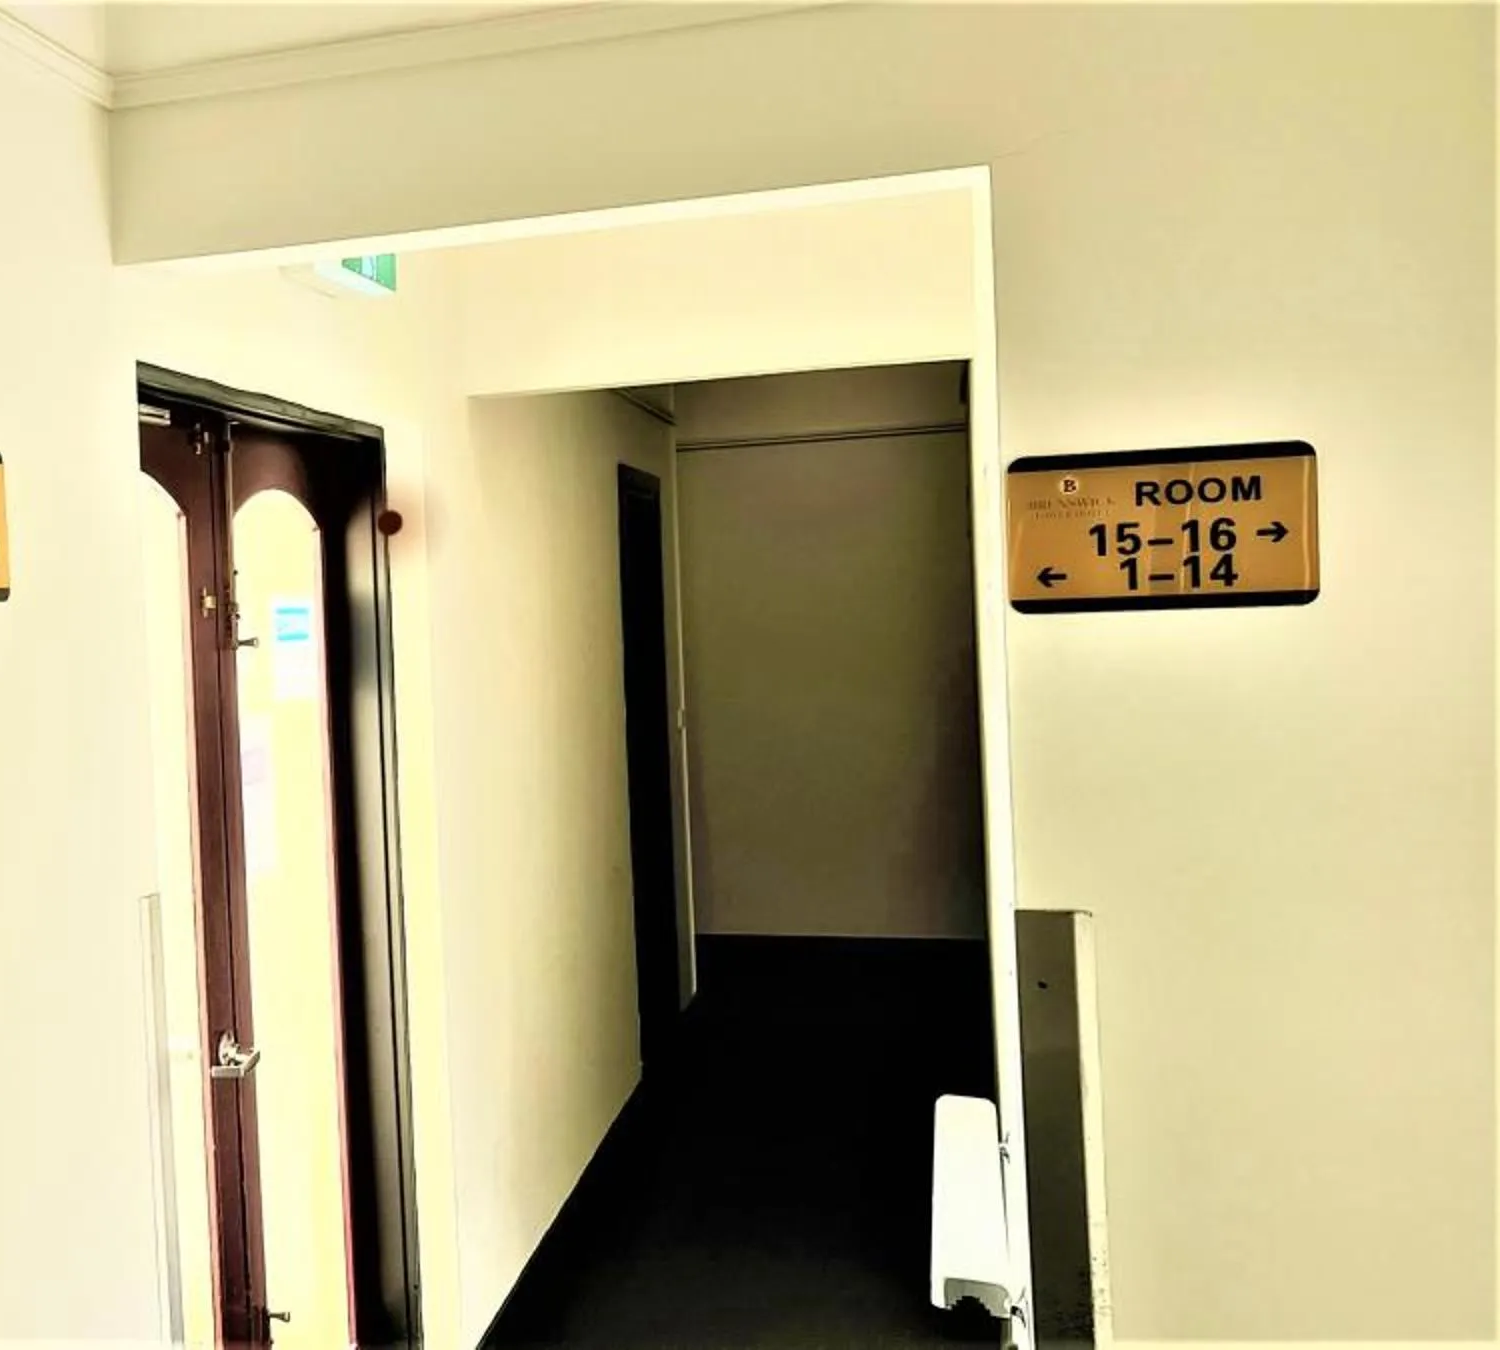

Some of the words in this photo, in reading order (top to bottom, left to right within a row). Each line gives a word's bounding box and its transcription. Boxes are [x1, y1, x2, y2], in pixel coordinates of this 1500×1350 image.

[1134, 474, 1263, 508] ROOM
[1088, 517, 1238, 557] 15-16
[1119, 553, 1239, 591] 1-14
